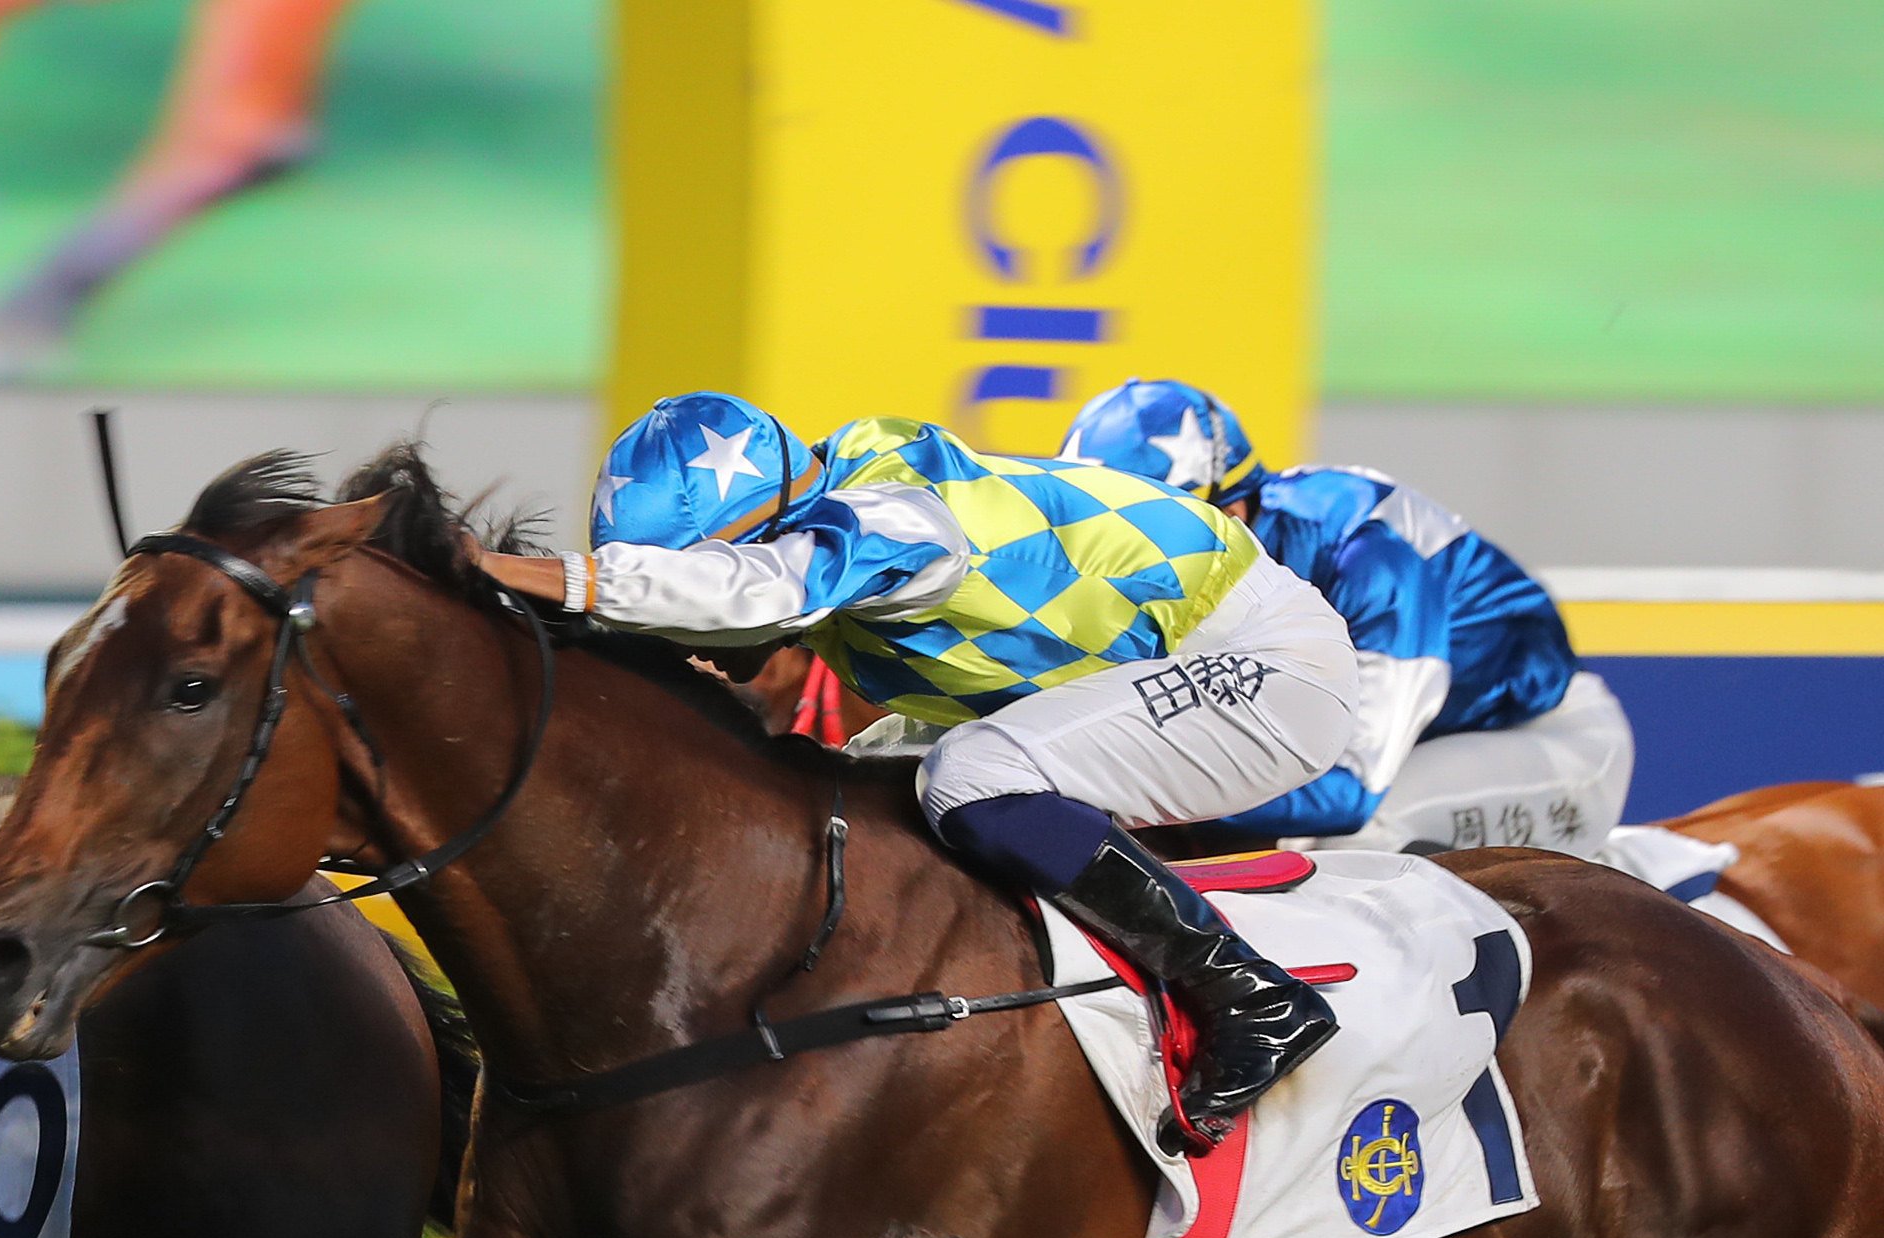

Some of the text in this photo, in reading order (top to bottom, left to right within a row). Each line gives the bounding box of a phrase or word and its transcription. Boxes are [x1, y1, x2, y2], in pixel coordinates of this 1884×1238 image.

[1131, 653, 1279, 728] 田泰安
[1452, 928, 1524, 1206] 1
